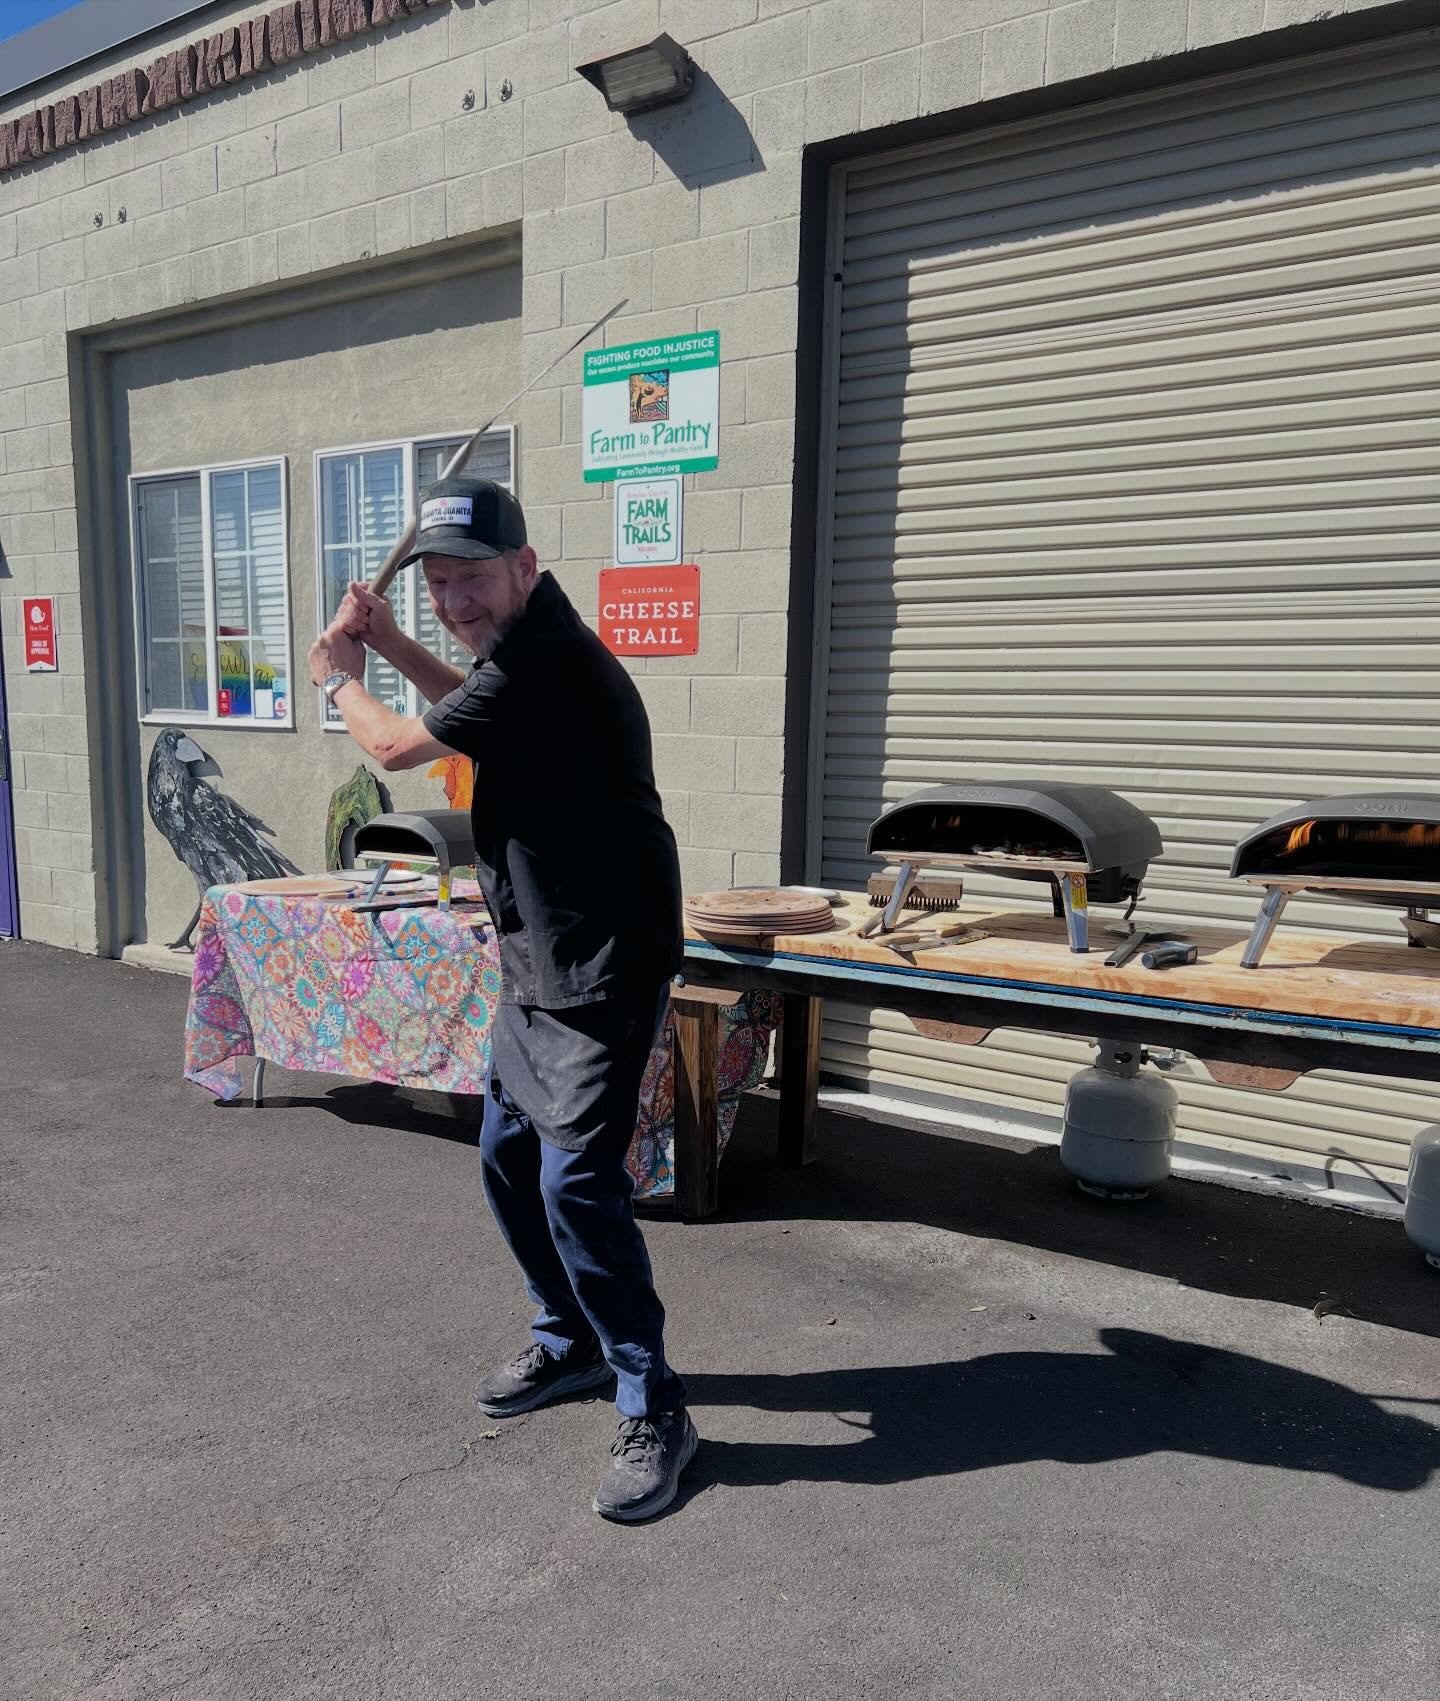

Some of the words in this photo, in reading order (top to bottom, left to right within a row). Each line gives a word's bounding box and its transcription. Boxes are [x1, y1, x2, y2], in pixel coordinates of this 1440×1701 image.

[587, 350, 631, 367] FIGHTING
[633, 346, 661, 359] FOOD
[663, 336, 715, 354] INJUSTICE
[616, 363, 640, 373] produce
[669, 355, 680, 363] our
[681, 350, 715, 361] community
[590, 429, 636, 454] Farm
[639, 432, 649, 445] to
[651, 419, 711, 449] Pantry
[616, 463, 680, 477] FarmToPantry.org
[443, 506, 471, 516] JUANITA
[627, 497, 668, 523] FARM
[623, 522, 672, 545] TRAILS
[621, 586, 674, 595] CALIFORNIA
[602, 600, 695, 620] CHEESE
[612, 627, 683, 645] TRAIL
